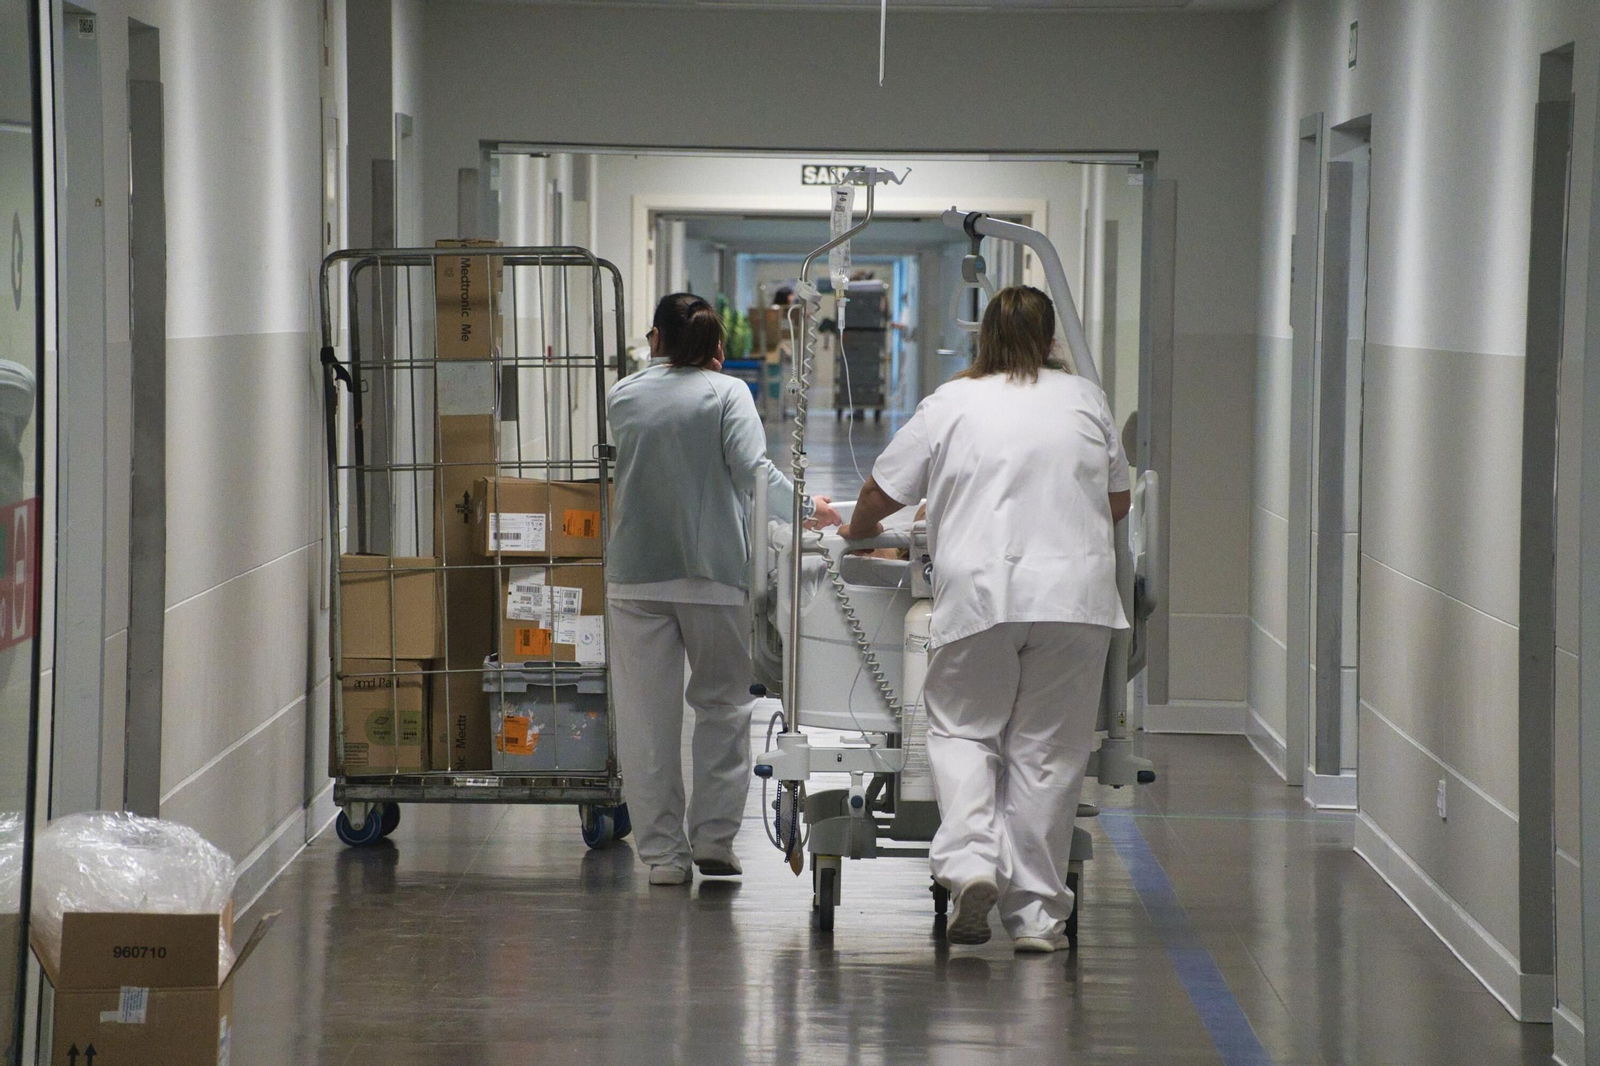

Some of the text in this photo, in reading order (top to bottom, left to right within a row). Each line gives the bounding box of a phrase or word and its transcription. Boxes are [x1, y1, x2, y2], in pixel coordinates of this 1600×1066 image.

[460, 257, 471, 318] Medtronic
[461, 323, 472, 342] Me
[112, 945, 168, 960] 960710
